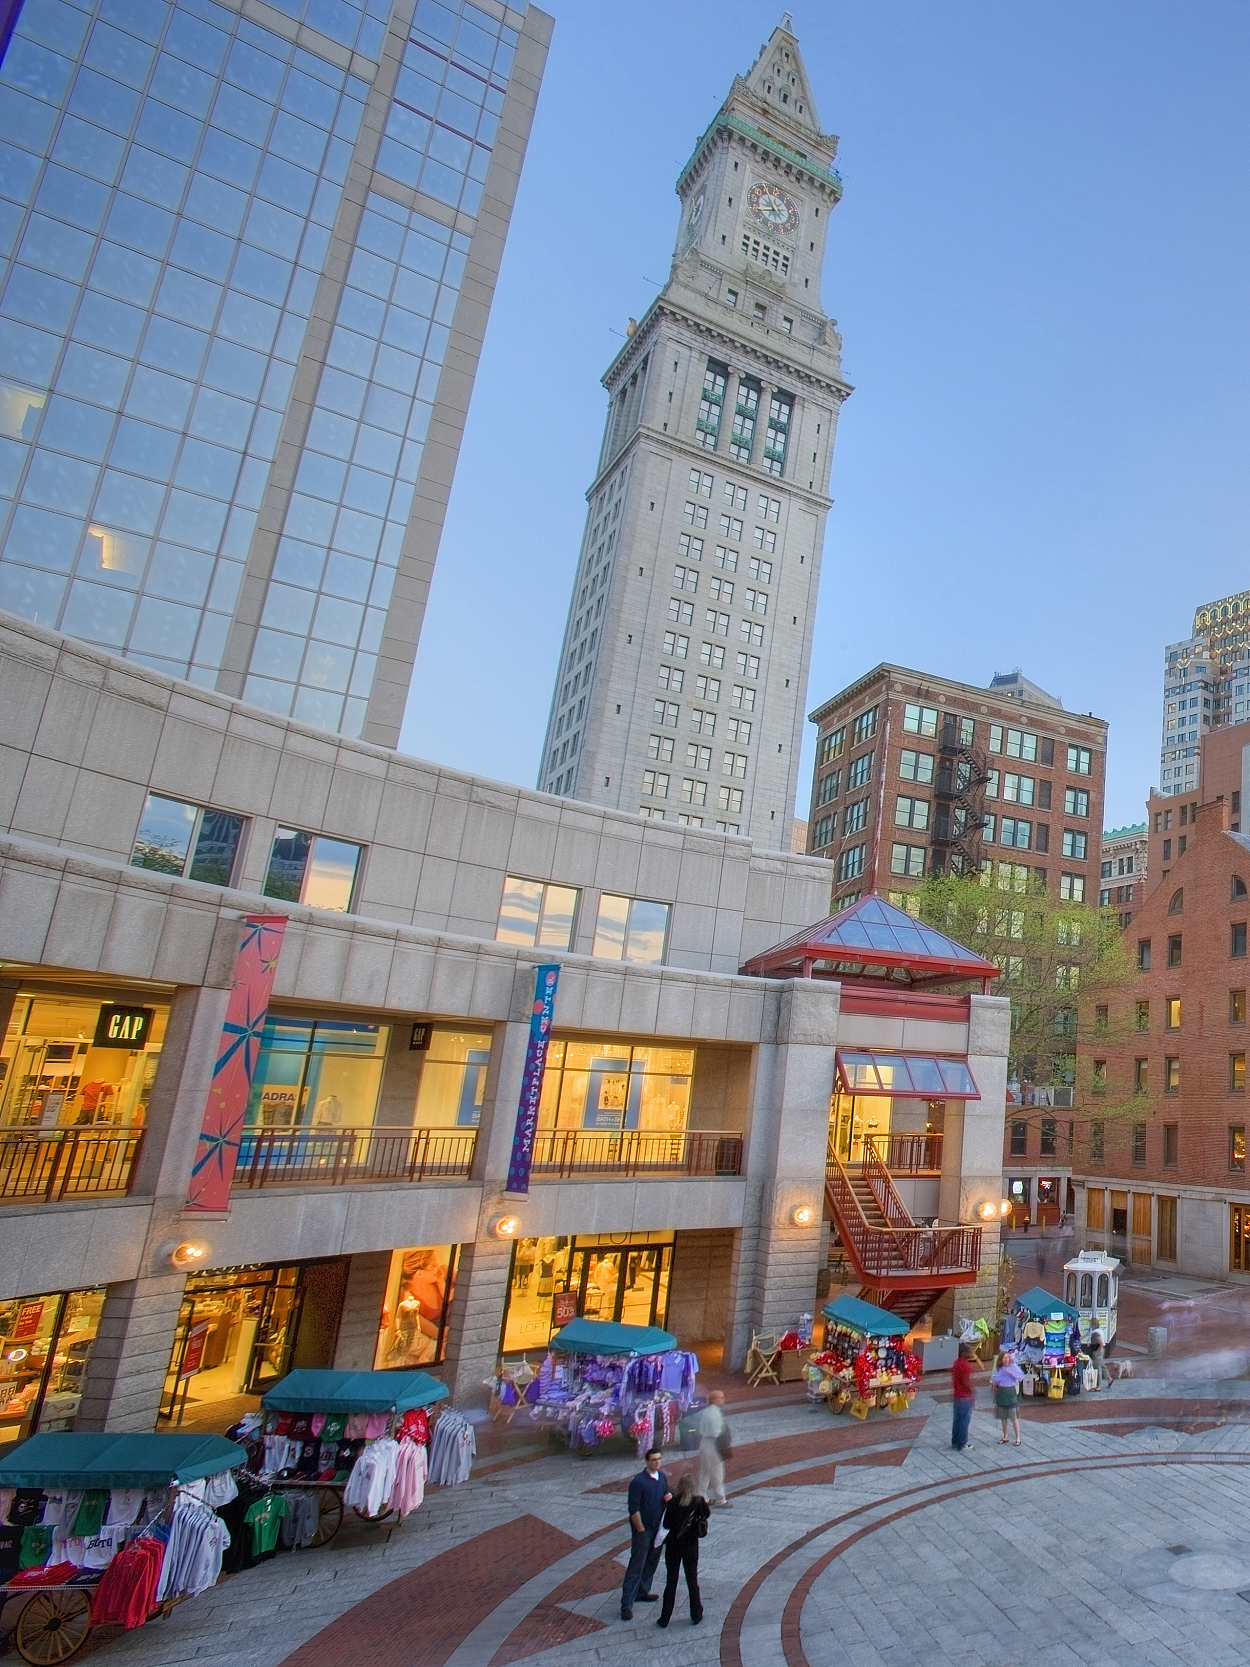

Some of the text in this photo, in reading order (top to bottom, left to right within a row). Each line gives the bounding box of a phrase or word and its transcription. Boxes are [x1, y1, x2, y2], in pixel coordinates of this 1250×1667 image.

[755, 188, 762, 196] 10
[773, 188, 780, 197] 12
[751, 194, 757, 202] 9
[753, 204, 759, 212] 8
[789, 206, 794, 214] 2
[759, 213, 764, 222] 7
[790, 215, 795, 224] 3
[767, 221, 773, 229] 6
[778, 224, 784, 233] 5
[785, 222, 791, 230] 4
[108, 1014, 144, 1040] GAP
[523, 976, 556, 1152] MARKETPLACE CENTER
[597, 1230, 660, 1246] LOFT
[22, 1304, 43, 1316] FREE
[519, 1321, 547, 1334] LOFT
